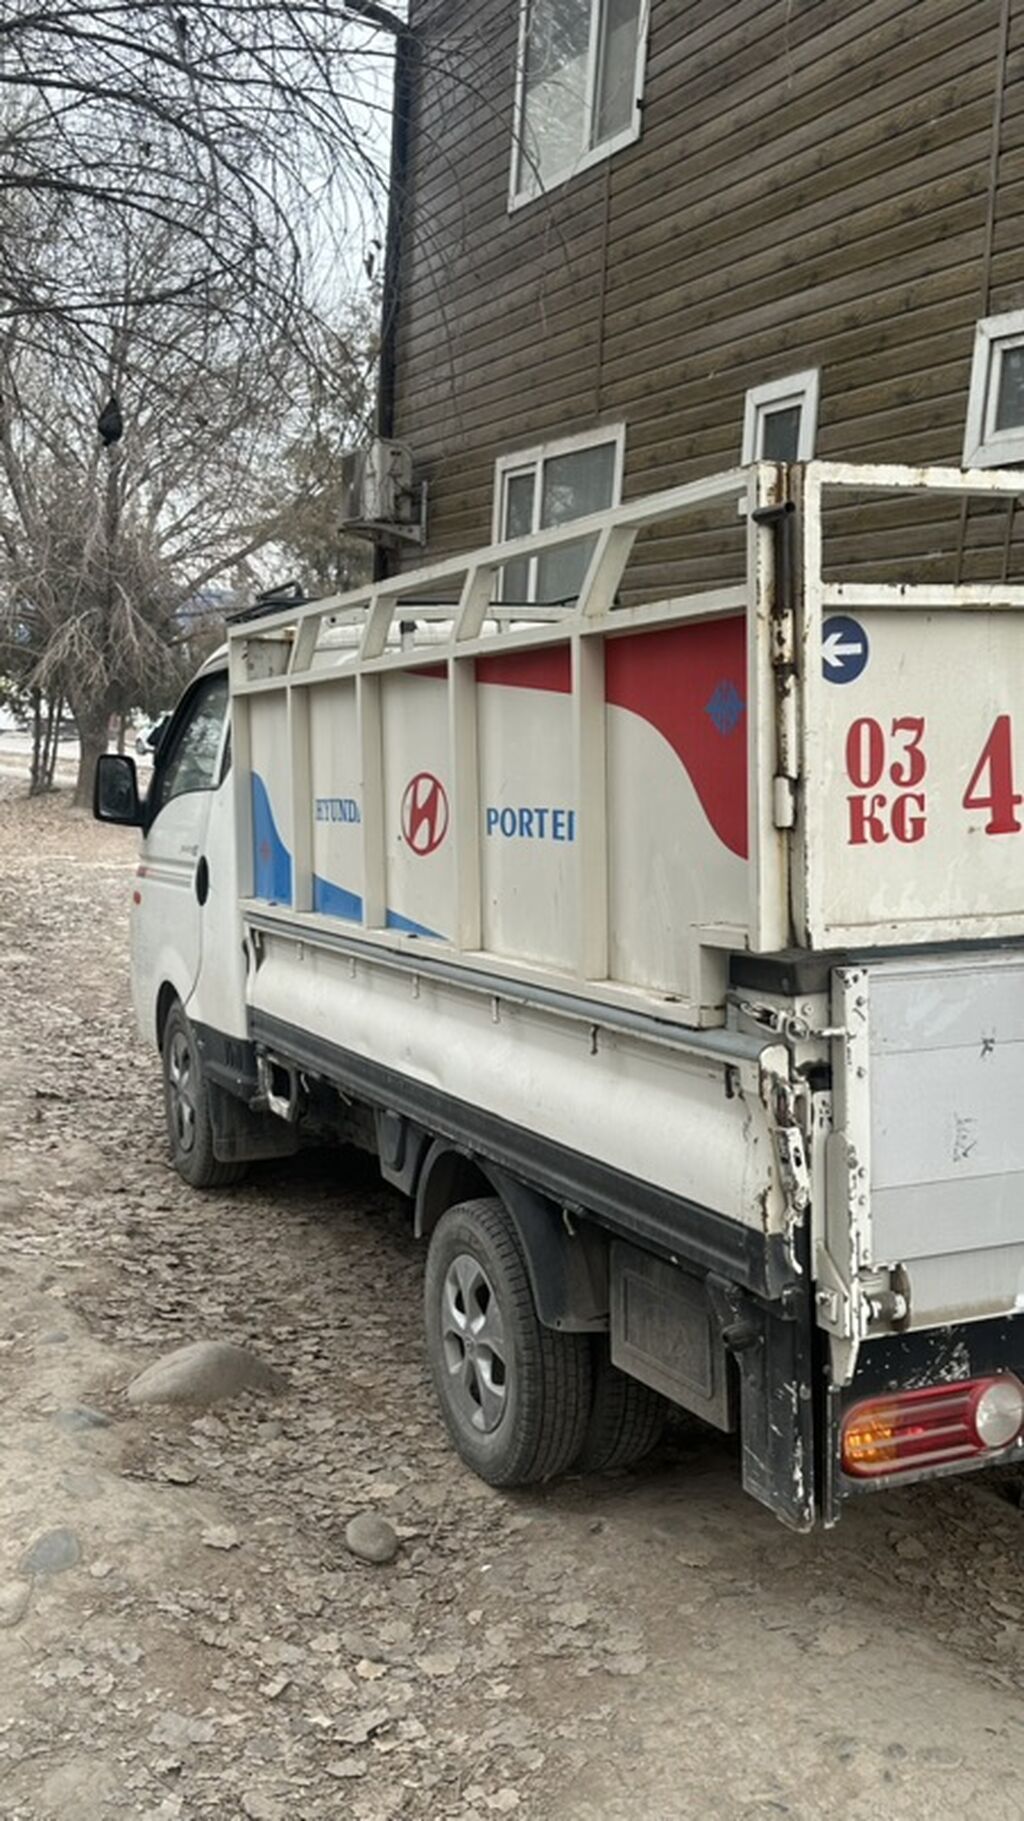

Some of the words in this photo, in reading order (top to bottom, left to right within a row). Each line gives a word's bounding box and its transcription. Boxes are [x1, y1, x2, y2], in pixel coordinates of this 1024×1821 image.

[845, 717, 926, 788] 03
[963, 715, 1023, 835] 4
[315, 798, 361, 823] HYUND
[847, 793, 927, 845] KG
